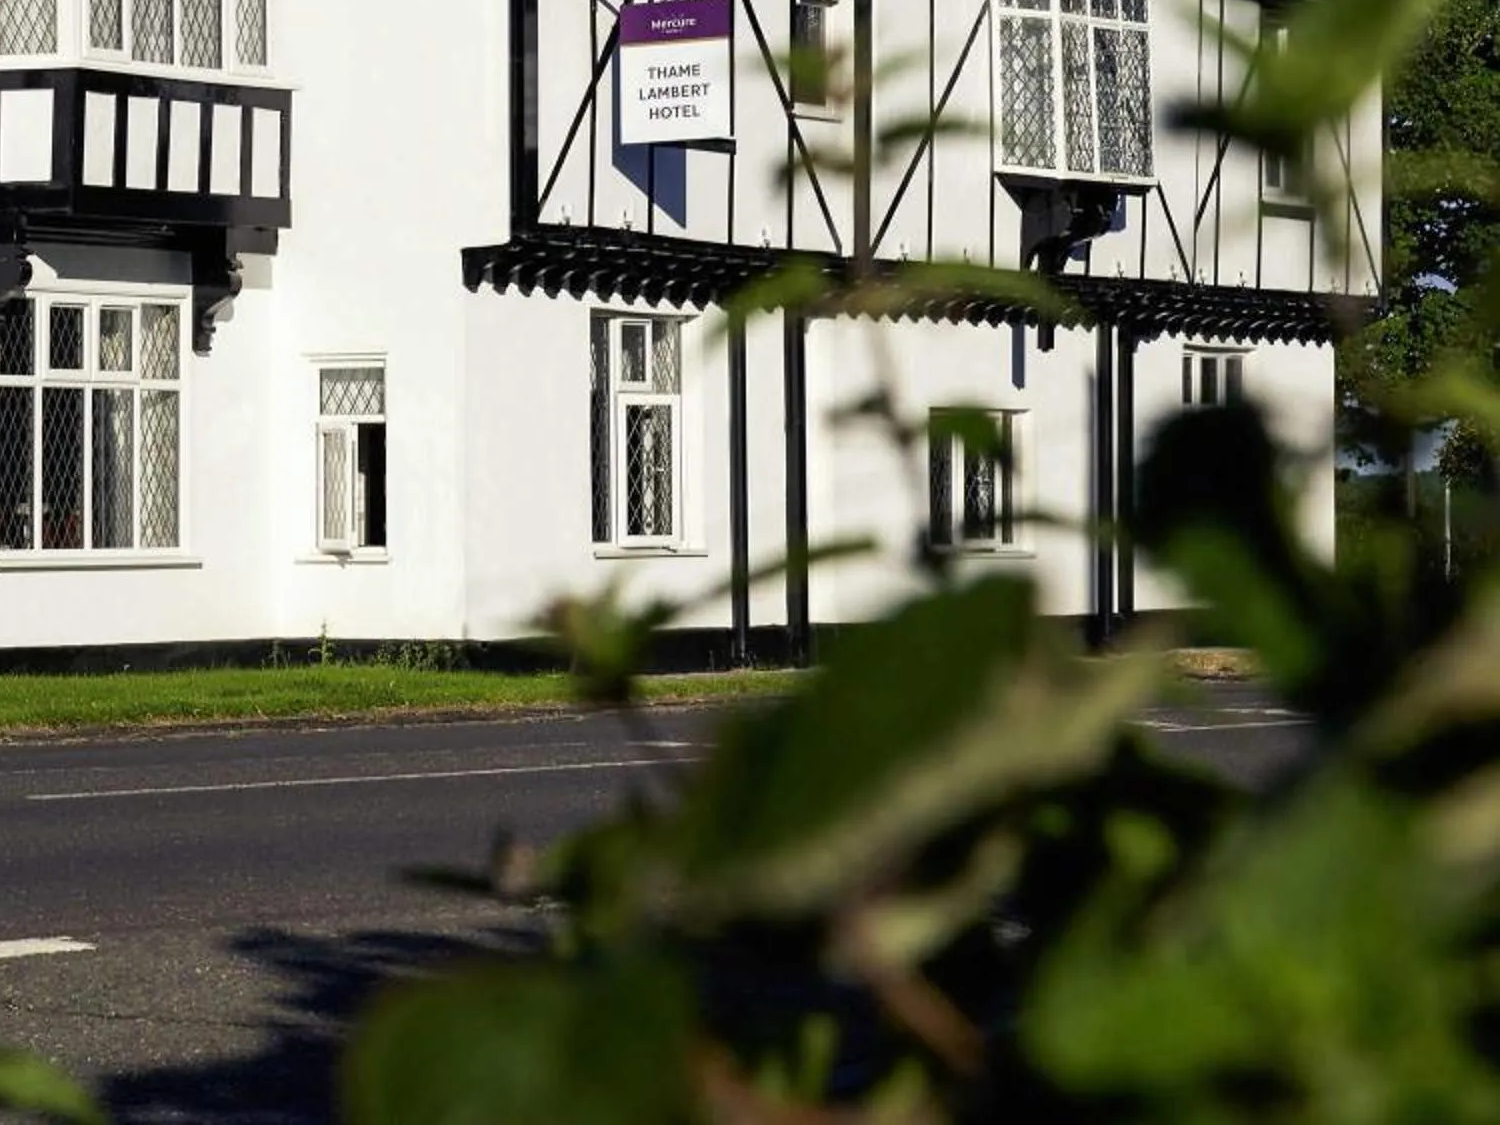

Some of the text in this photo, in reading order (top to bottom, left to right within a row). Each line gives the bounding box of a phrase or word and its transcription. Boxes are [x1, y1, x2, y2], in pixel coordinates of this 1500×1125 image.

[651, 17, 697, 30] Mercure
[648, 63, 701, 79] THAME
[639, 83, 710, 101] LAMBERT
[649, 104, 701, 120] HOTEL
